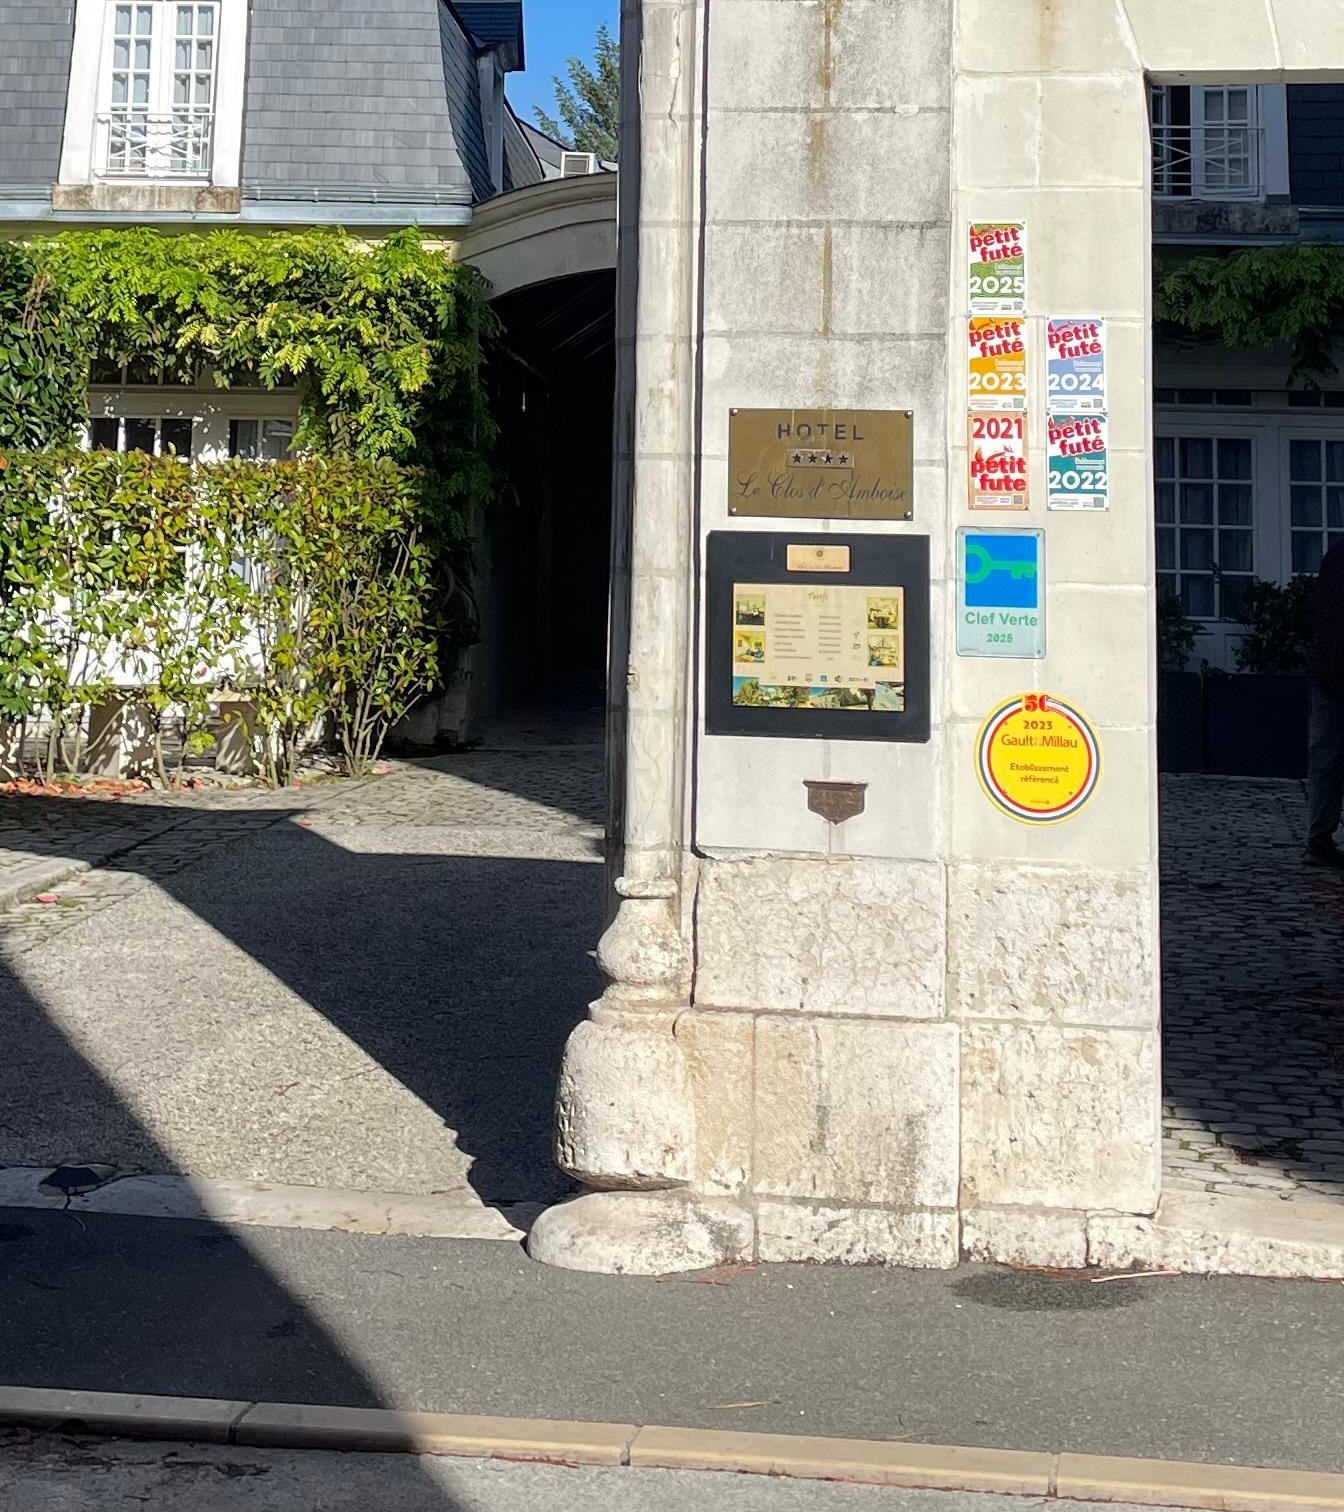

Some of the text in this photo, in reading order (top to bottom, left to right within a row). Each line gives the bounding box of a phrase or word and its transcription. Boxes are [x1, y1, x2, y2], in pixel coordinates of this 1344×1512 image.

[969, 226, 1021, 252] petit
[980, 242, 1024, 263] futé
[969, 276, 1025, 294] 2025
[968, 320, 1022, 347] petit
[1047, 323, 1099, 349] petit
[979, 337, 1025, 358] futé
[1058, 338, 1103, 360] futé
[969, 372, 1026, 391] 2023
[1048, 373, 1104, 391] 2024
[972, 417, 1023, 440] 2021
[1048, 417, 1102, 445] petit
[1059, 435, 1105, 457] futé
[970, 455, 1027, 478] petit
[736, 471, 761, 500] Le
[767, 471, 804, 500] Clos
[1048, 470, 1108, 490] 2022
[964, 611, 1039, 628] Clef Verte
[1023, 720, 1053, 730] 2023
[1001, 734, 1078, 750] GaultMillau
